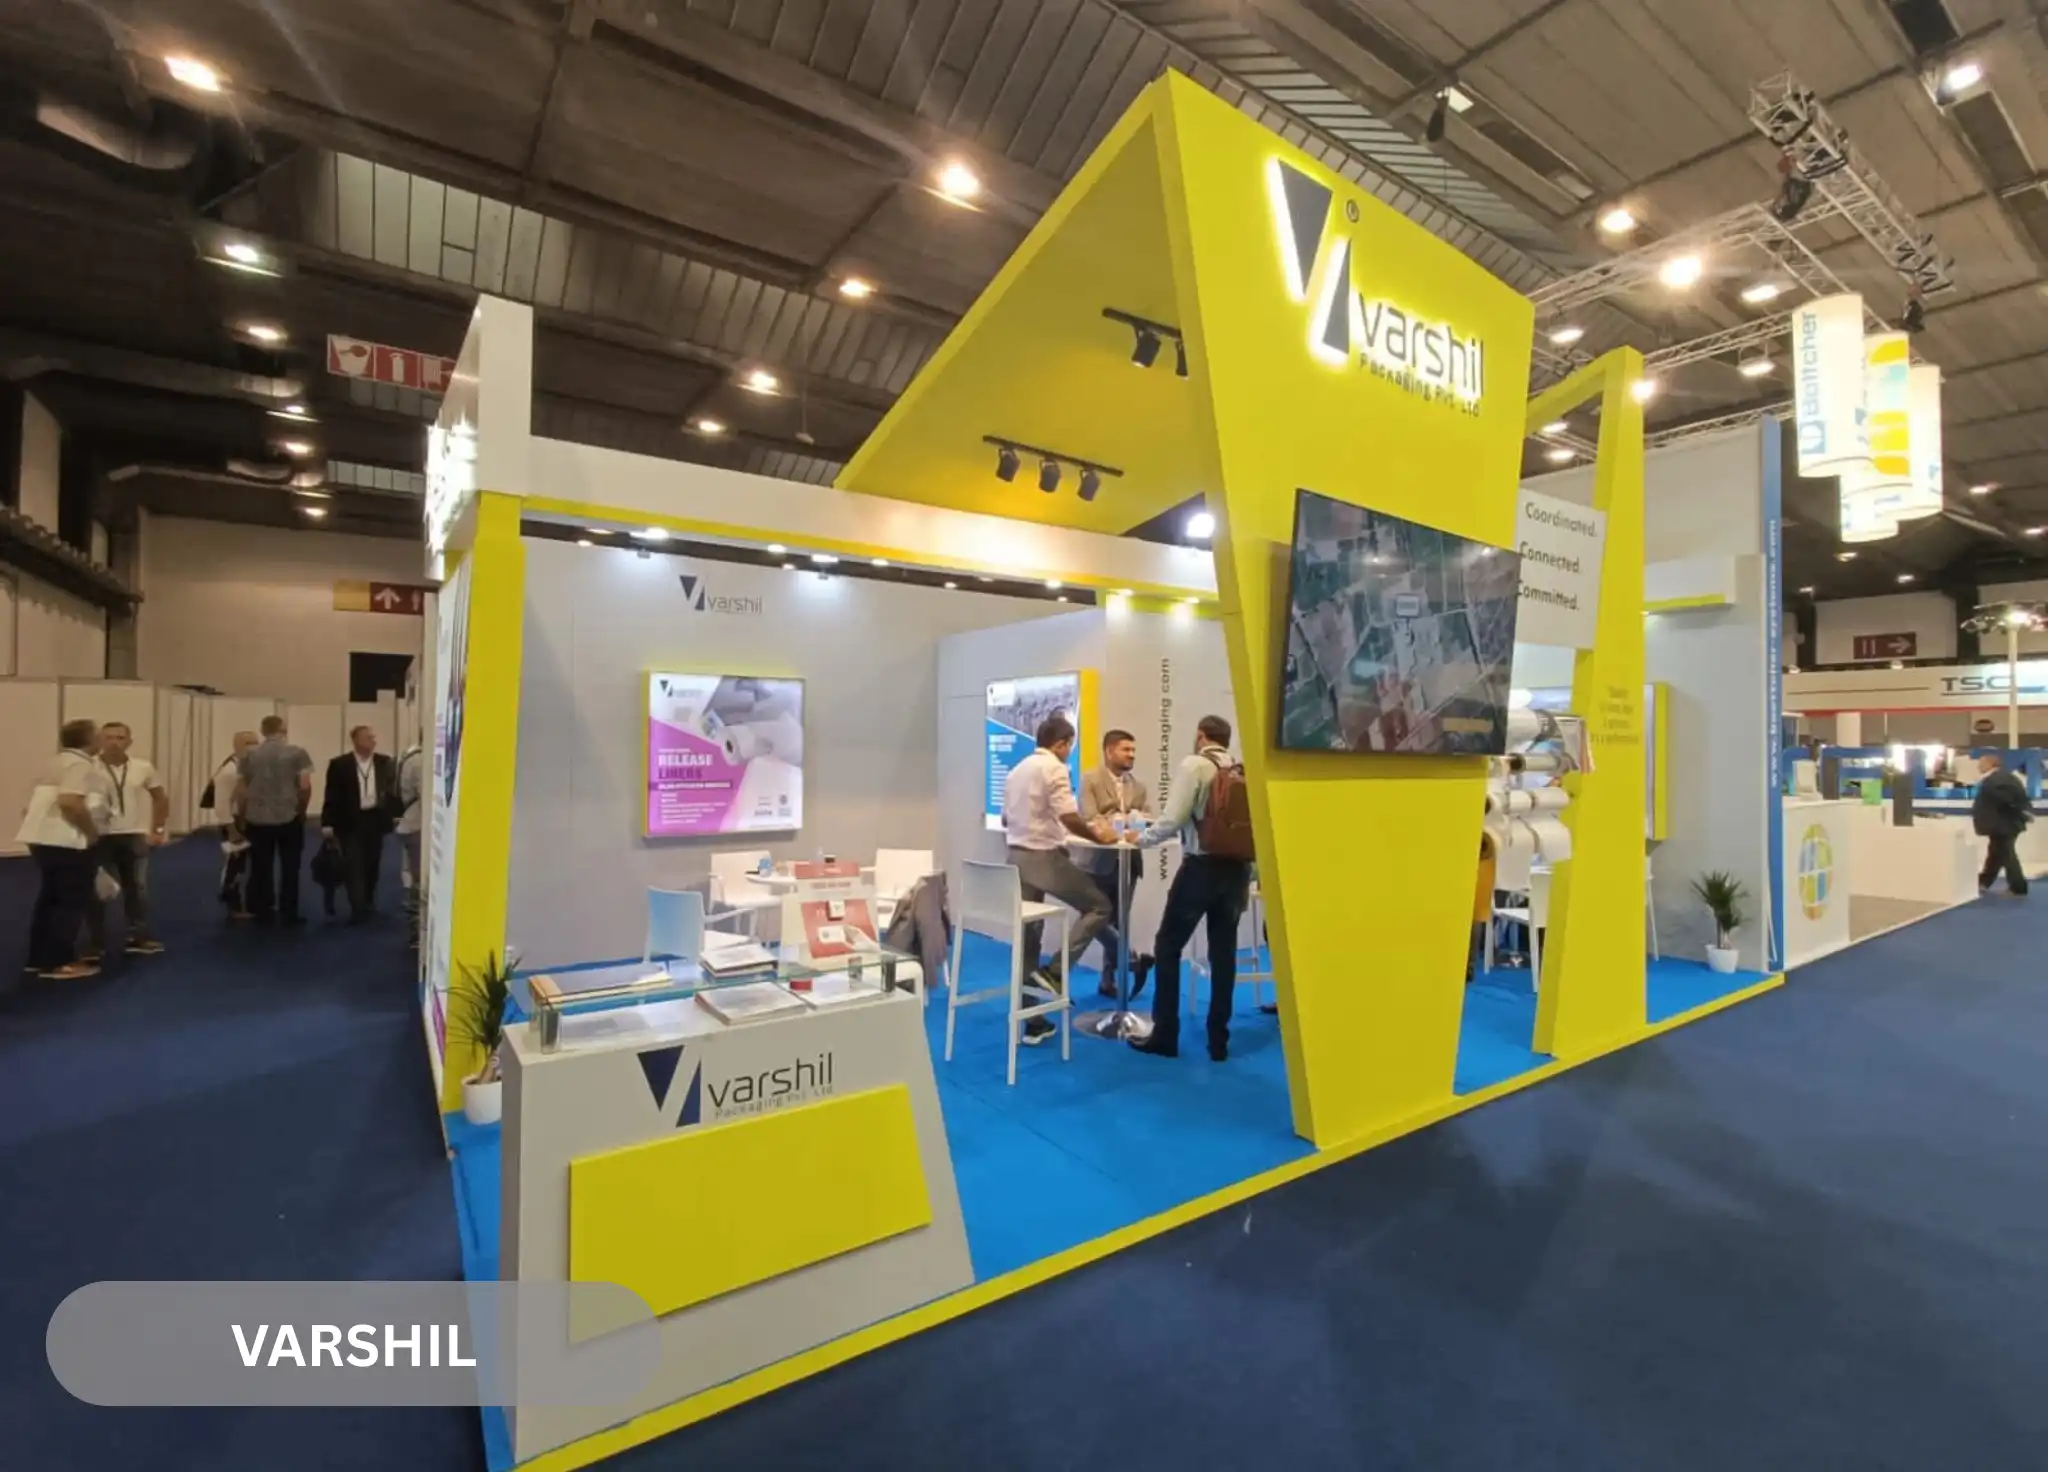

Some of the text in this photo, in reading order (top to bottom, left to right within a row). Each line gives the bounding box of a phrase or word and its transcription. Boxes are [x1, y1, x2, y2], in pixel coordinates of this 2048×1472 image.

[1359, 292, 1484, 398] varshil
[1359, 352, 1431, 401] Packaging
[1525, 502, 1597, 537] Coordinated.
[707, 596, 763, 615] varshil
[658, 753, 713, 767] RELEASE
[707, 1052, 833, 1108] varshil
[714, 1096, 782, 1119] Packaging
